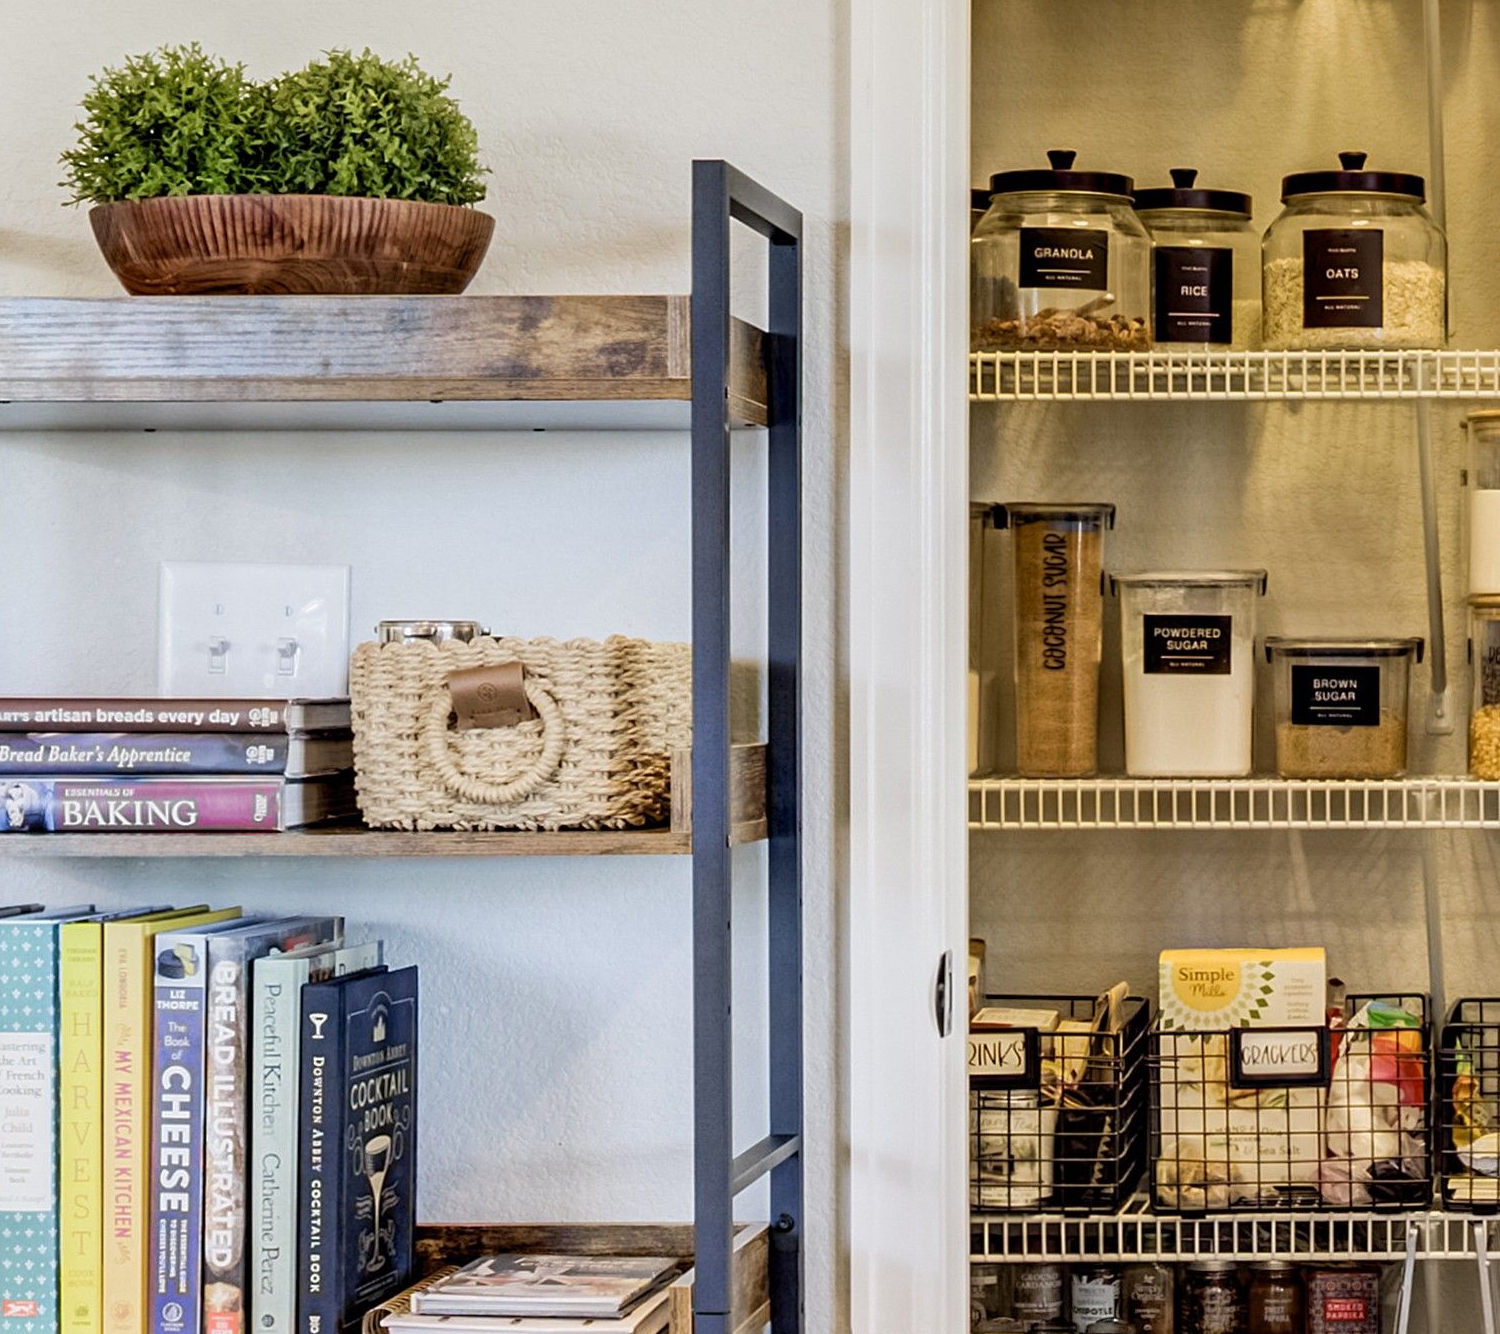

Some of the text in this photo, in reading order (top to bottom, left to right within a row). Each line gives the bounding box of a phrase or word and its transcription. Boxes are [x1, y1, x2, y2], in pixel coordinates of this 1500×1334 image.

[1034, 247, 1094, 260] GRANOLA
[1326, 268, 1359, 279] OATS
[1180, 285, 1208, 297] RICE
[1043, 533, 1067, 670] COCONUT SUGAR
[1153, 628, 1221, 638] POWDERED
[1166, 639, 1208, 650] SUGAR
[1313, 678, 1358, 689] BROWN
[1315, 691, 1356, 702] SUGAR
[34, 707, 92, 723] artisan
[96, 708, 154, 723] breads
[158, 712, 204, 726] every
[209, 709, 240, 726] day
[48, 745, 104, 762] Baker's
[106, 745, 191, 768] Apprentice
[64, 788, 135, 797] ESSENTIALS OF
[62, 799, 198, 827] BAKING
[1178, 967, 1235, 983] Simple
[169, 990, 186, 999] LIZ
[1188, 983, 1226, 998] Mills
[156, 1000, 199, 1011] THORPE
[168, 1021, 187, 1033] The
[164, 1035, 190, 1047] Book
[171, 1050, 182, 1061] of
[1241, 1042, 1317, 1066] CRACKERS
[18, 1055, 37, 1066] Art
[5, 1070, 45, 1080] French
[350, 1069, 409, 1110] COCKTAIL
[4, 1107, 30, 1118] Julia
[211, 960, 237, 1268] BREAD ILLUSTRATED
[364, 1102, 394, 1132] BOOK
[1, 1122, 33, 1133] Child
[114, 1050, 133, 1238] MY MEXICAN KITCHEN
[160, 1066, 192, 1213] CHEESE
[260, 983, 282, 1295] Peaceful Kitchen Catherine Perez
[1279, 1143, 1301, 1156] Slt
[309, 1056, 325, 1293] DOWNTON ABBEY COCKTAIL BOOK
[1326, 1303, 1364, 1311] SMOKED
